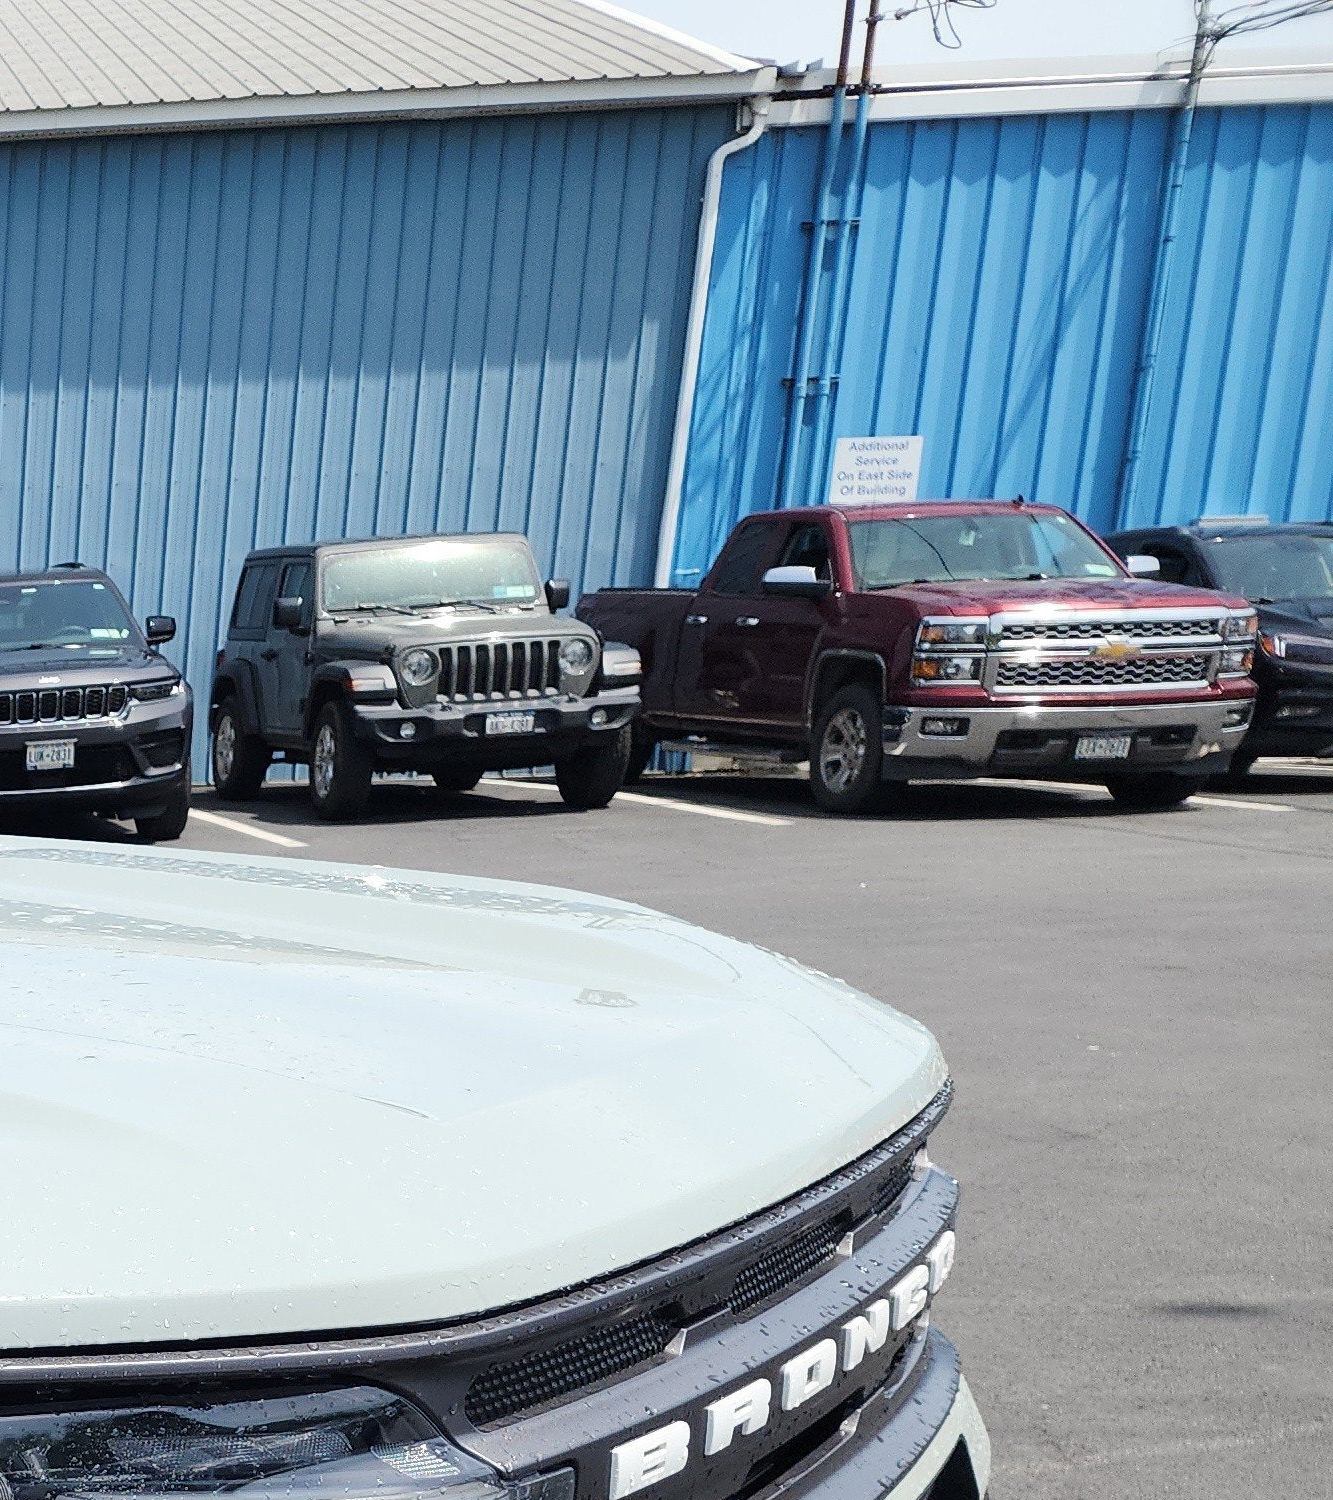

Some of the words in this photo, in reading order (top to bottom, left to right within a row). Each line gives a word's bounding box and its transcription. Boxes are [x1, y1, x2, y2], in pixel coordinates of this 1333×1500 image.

[848, 441, 909, 452] Additional
[854, 456, 899, 466] Service
[837, 471, 854, 481] On
[858, 472, 884, 481] East
[887, 470, 913, 480] Side
[840, 486, 854, 496] Of
[857, 485, 907, 497] Building
[609, 1230, 955, 1500] BRONCO
